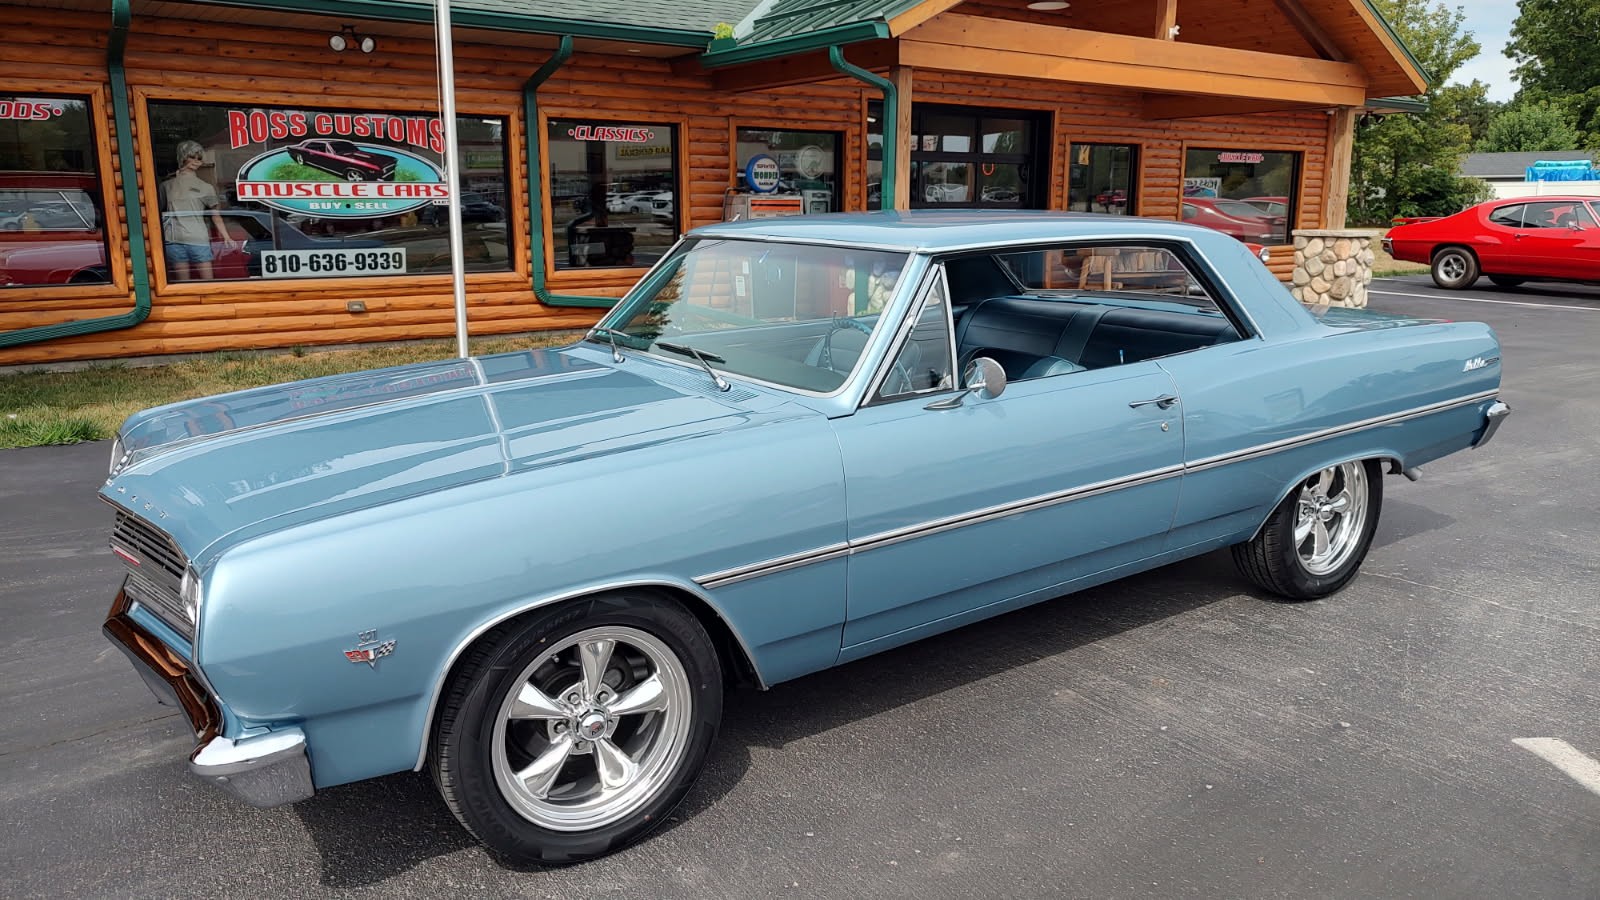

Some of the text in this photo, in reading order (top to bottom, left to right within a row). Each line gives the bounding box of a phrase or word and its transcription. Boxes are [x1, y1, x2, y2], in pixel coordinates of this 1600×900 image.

[228, 110, 447, 154] ROSS CUSTOMS
[575, 125, 648, 143] CLASSICS
[238, 183, 449, 197] MUSCLE CARS
[309, 202, 389, 210] BUY SELL
[265, 252, 403, 273] 810-636-9339
